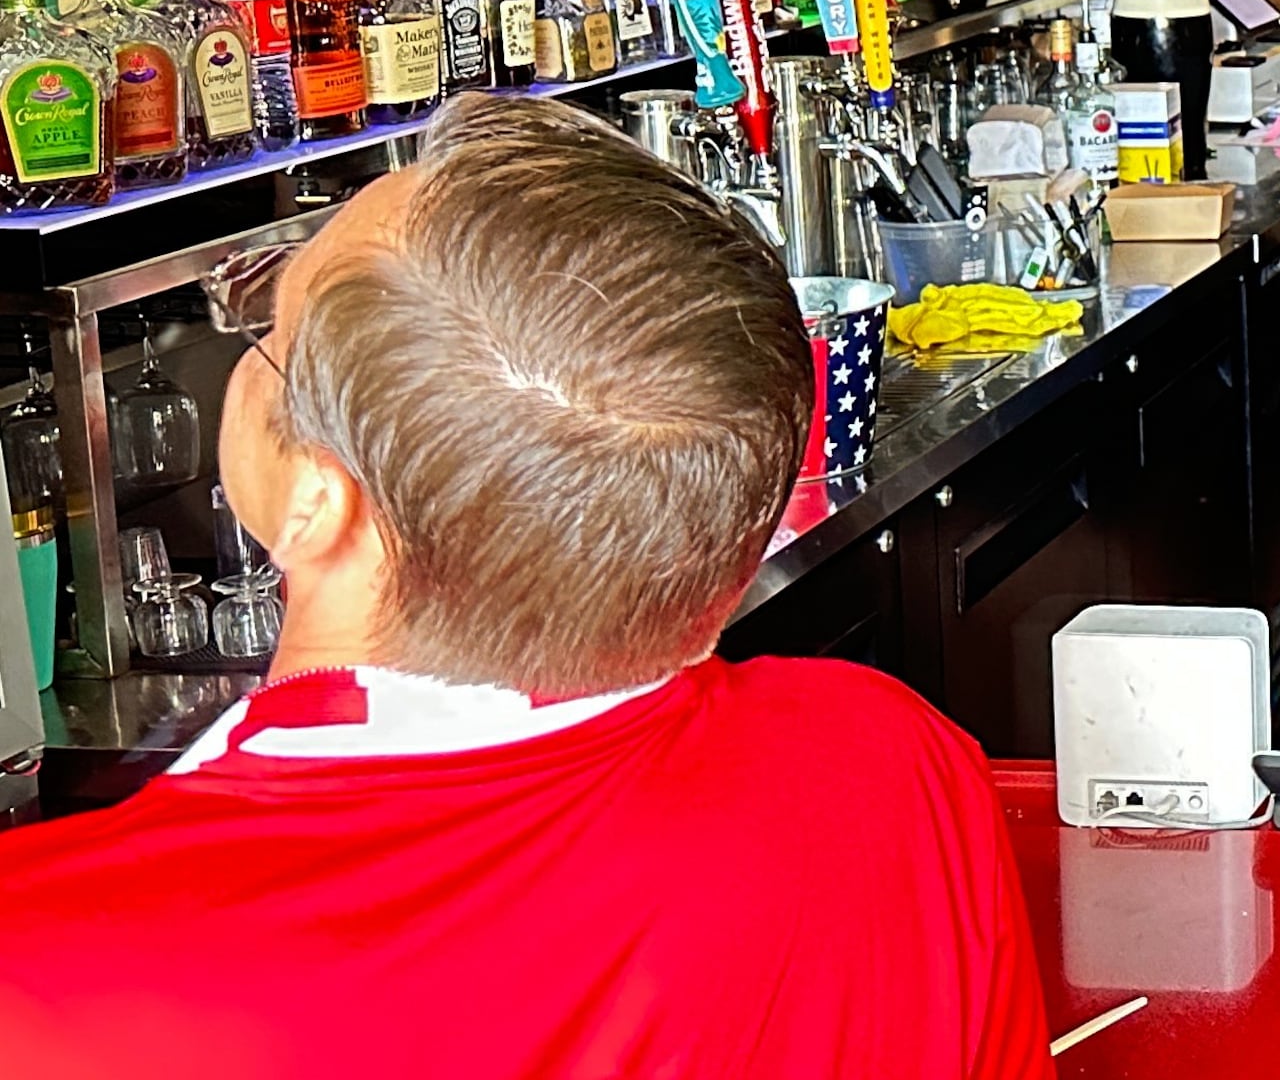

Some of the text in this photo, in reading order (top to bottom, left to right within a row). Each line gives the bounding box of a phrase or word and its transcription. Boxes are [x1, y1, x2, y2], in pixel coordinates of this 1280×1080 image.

[870, 30, 884, 81] WHITE
[209, 88, 244, 102] VANILLA
[15, 101, 90, 126] Crown Royal
[122, 106, 168, 120] PEACH
[32, 128, 83, 144] APPLE
